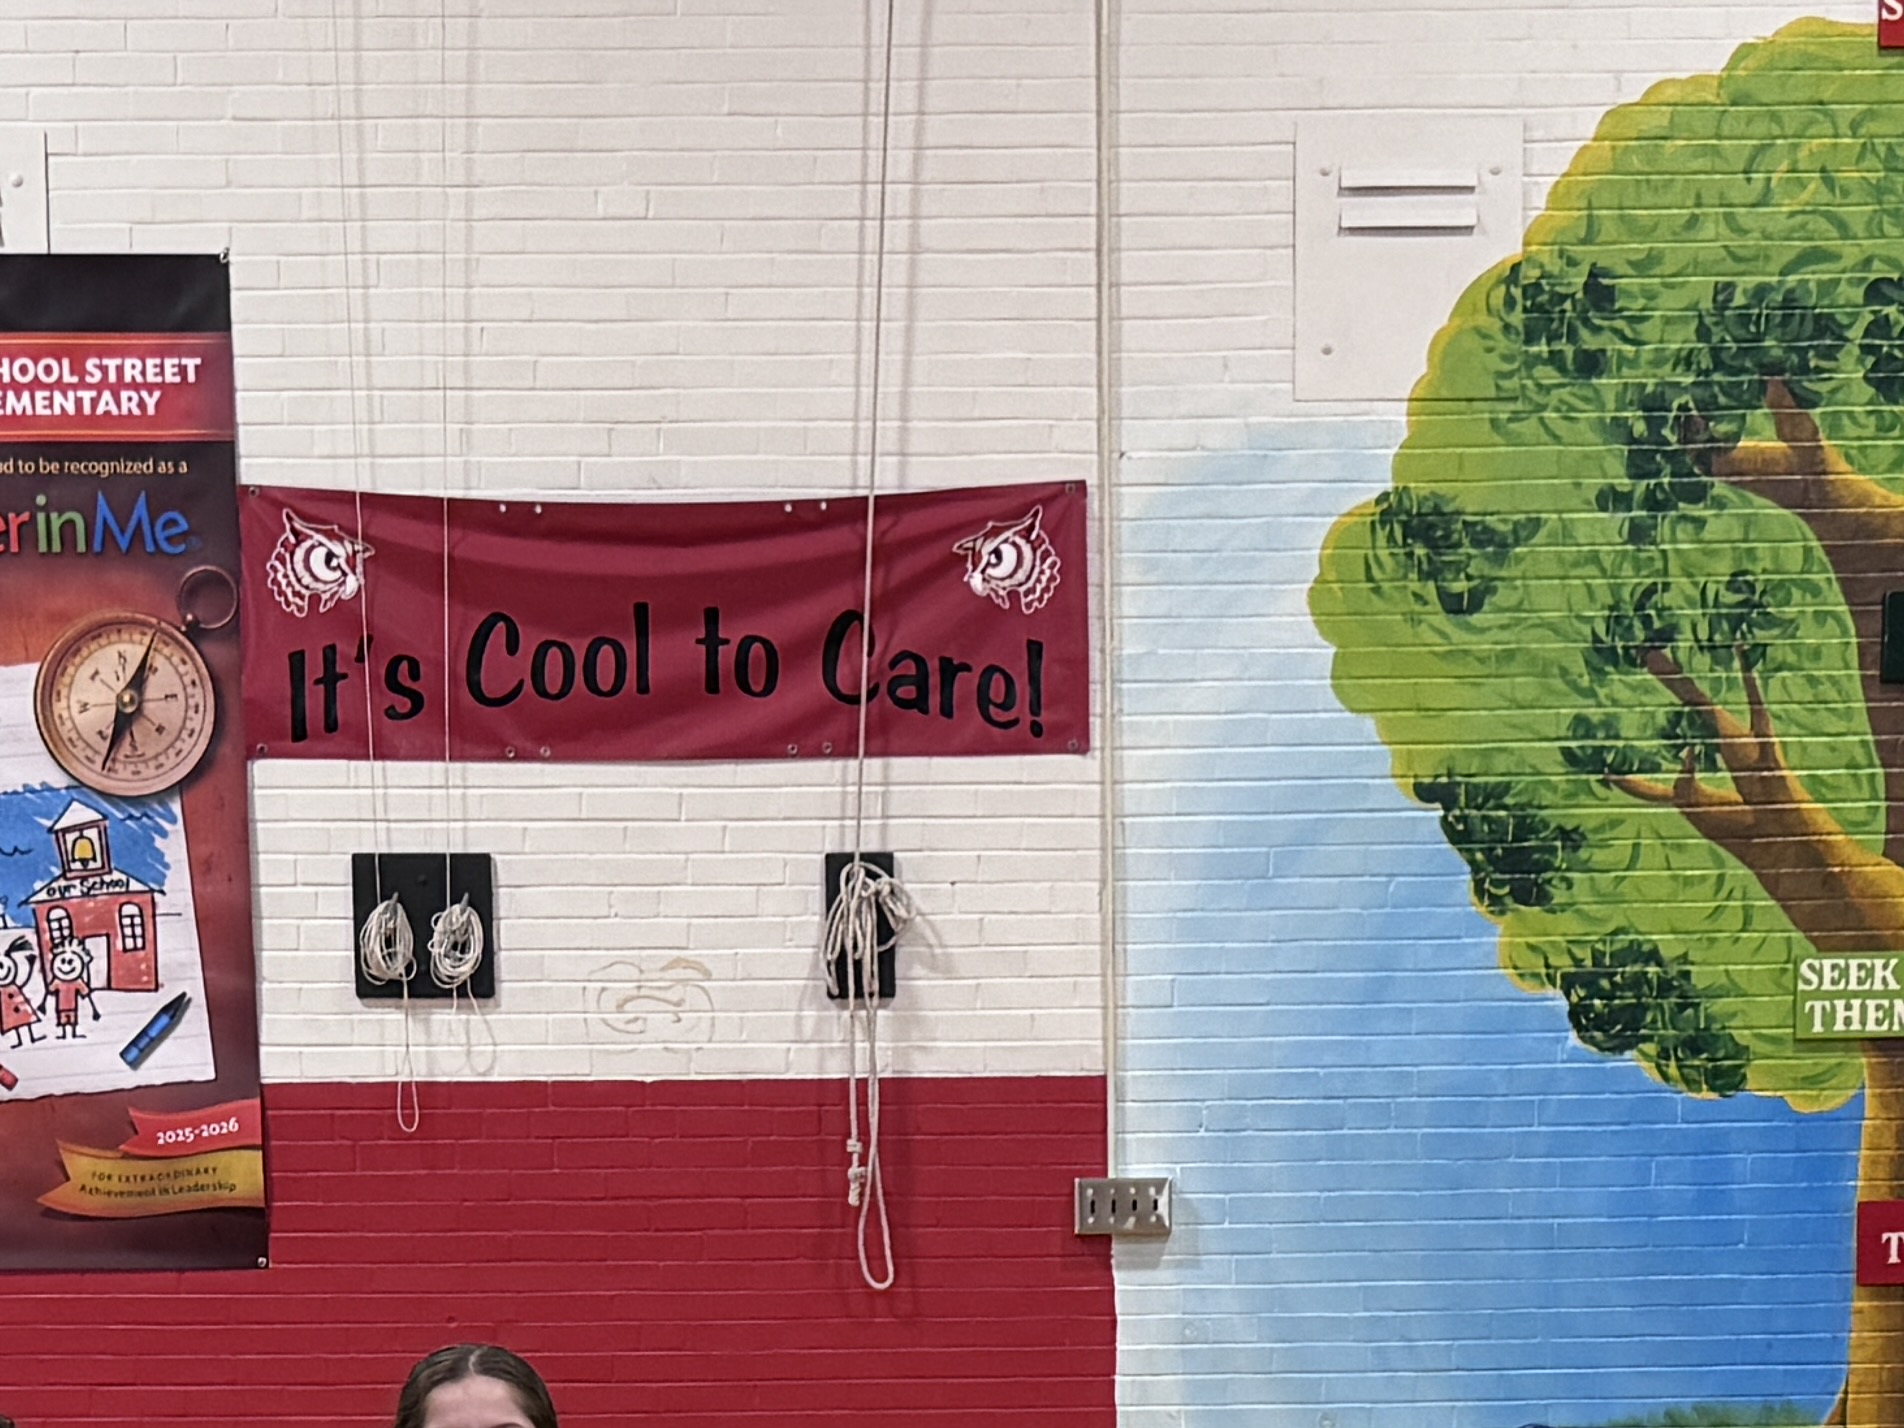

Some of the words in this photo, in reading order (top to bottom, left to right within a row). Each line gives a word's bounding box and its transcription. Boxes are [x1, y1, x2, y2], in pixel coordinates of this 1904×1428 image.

[85, 357, 201, 384] STREET
[18, 460, 35, 474] to
[39, 459, 60, 474] be
[64, 458, 153, 478] recognized
[157, 462, 175, 474] as
[178, 462, 188, 474] a
[37, 495, 87, 554] in
[288, 633, 425, 743] It's
[465, 602, 649, 709] Cool
[695, 605, 779, 698] to
[821, 609, 1044, 738] Care!
[80, 876, 129, 896] School
[1799, 959, 1901, 992] SEEK
[156, 1117, 239, 1145] 2025-2026
[92, 1172, 111, 1181] FOR
[118, 1167, 218, 1182] EXTRAORDINARY
[80, 1184, 155, 1199] Achievement
[159, 1186, 169, 1196] in
[171, 1182, 236, 1195] Leadership
